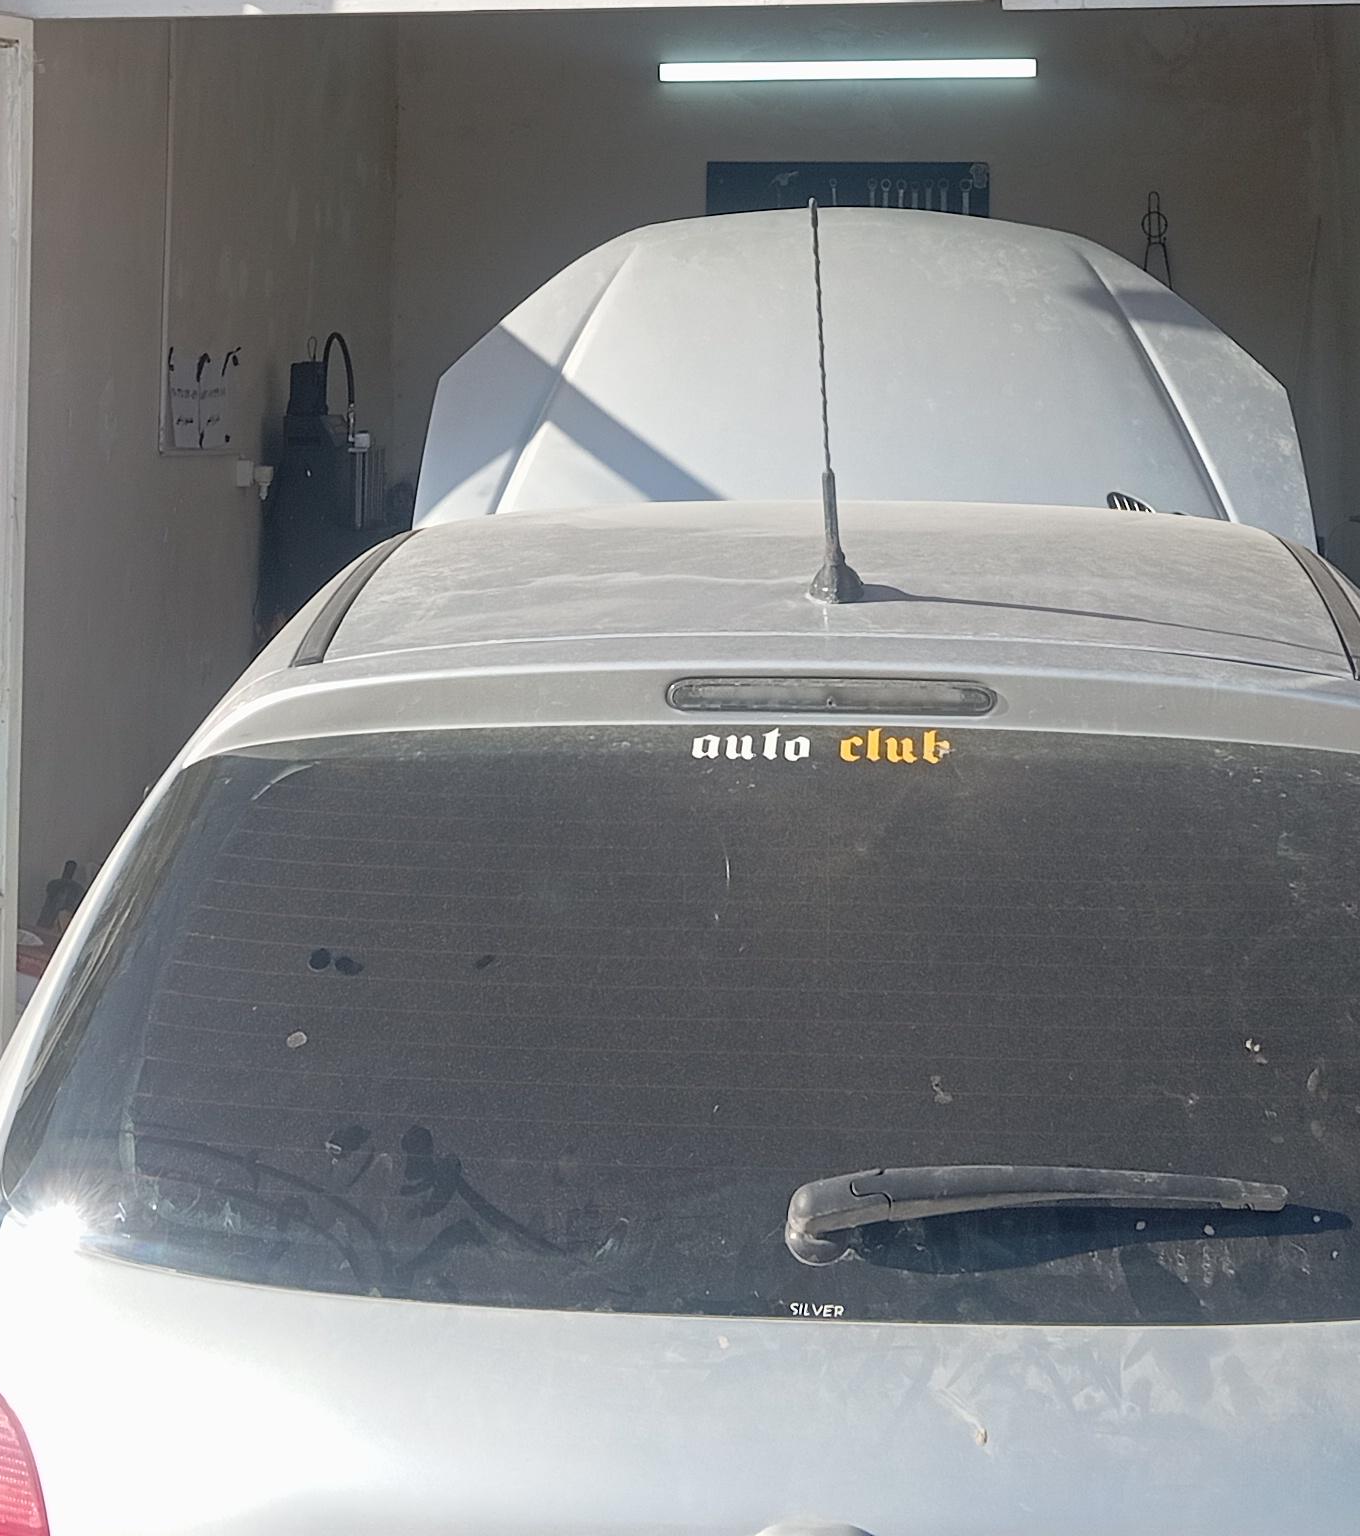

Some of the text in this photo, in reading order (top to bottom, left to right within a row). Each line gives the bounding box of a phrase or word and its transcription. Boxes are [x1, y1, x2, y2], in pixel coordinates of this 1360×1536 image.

[690, 727, 952, 764] auto club
[789, 1302, 845, 1318] SILVER
